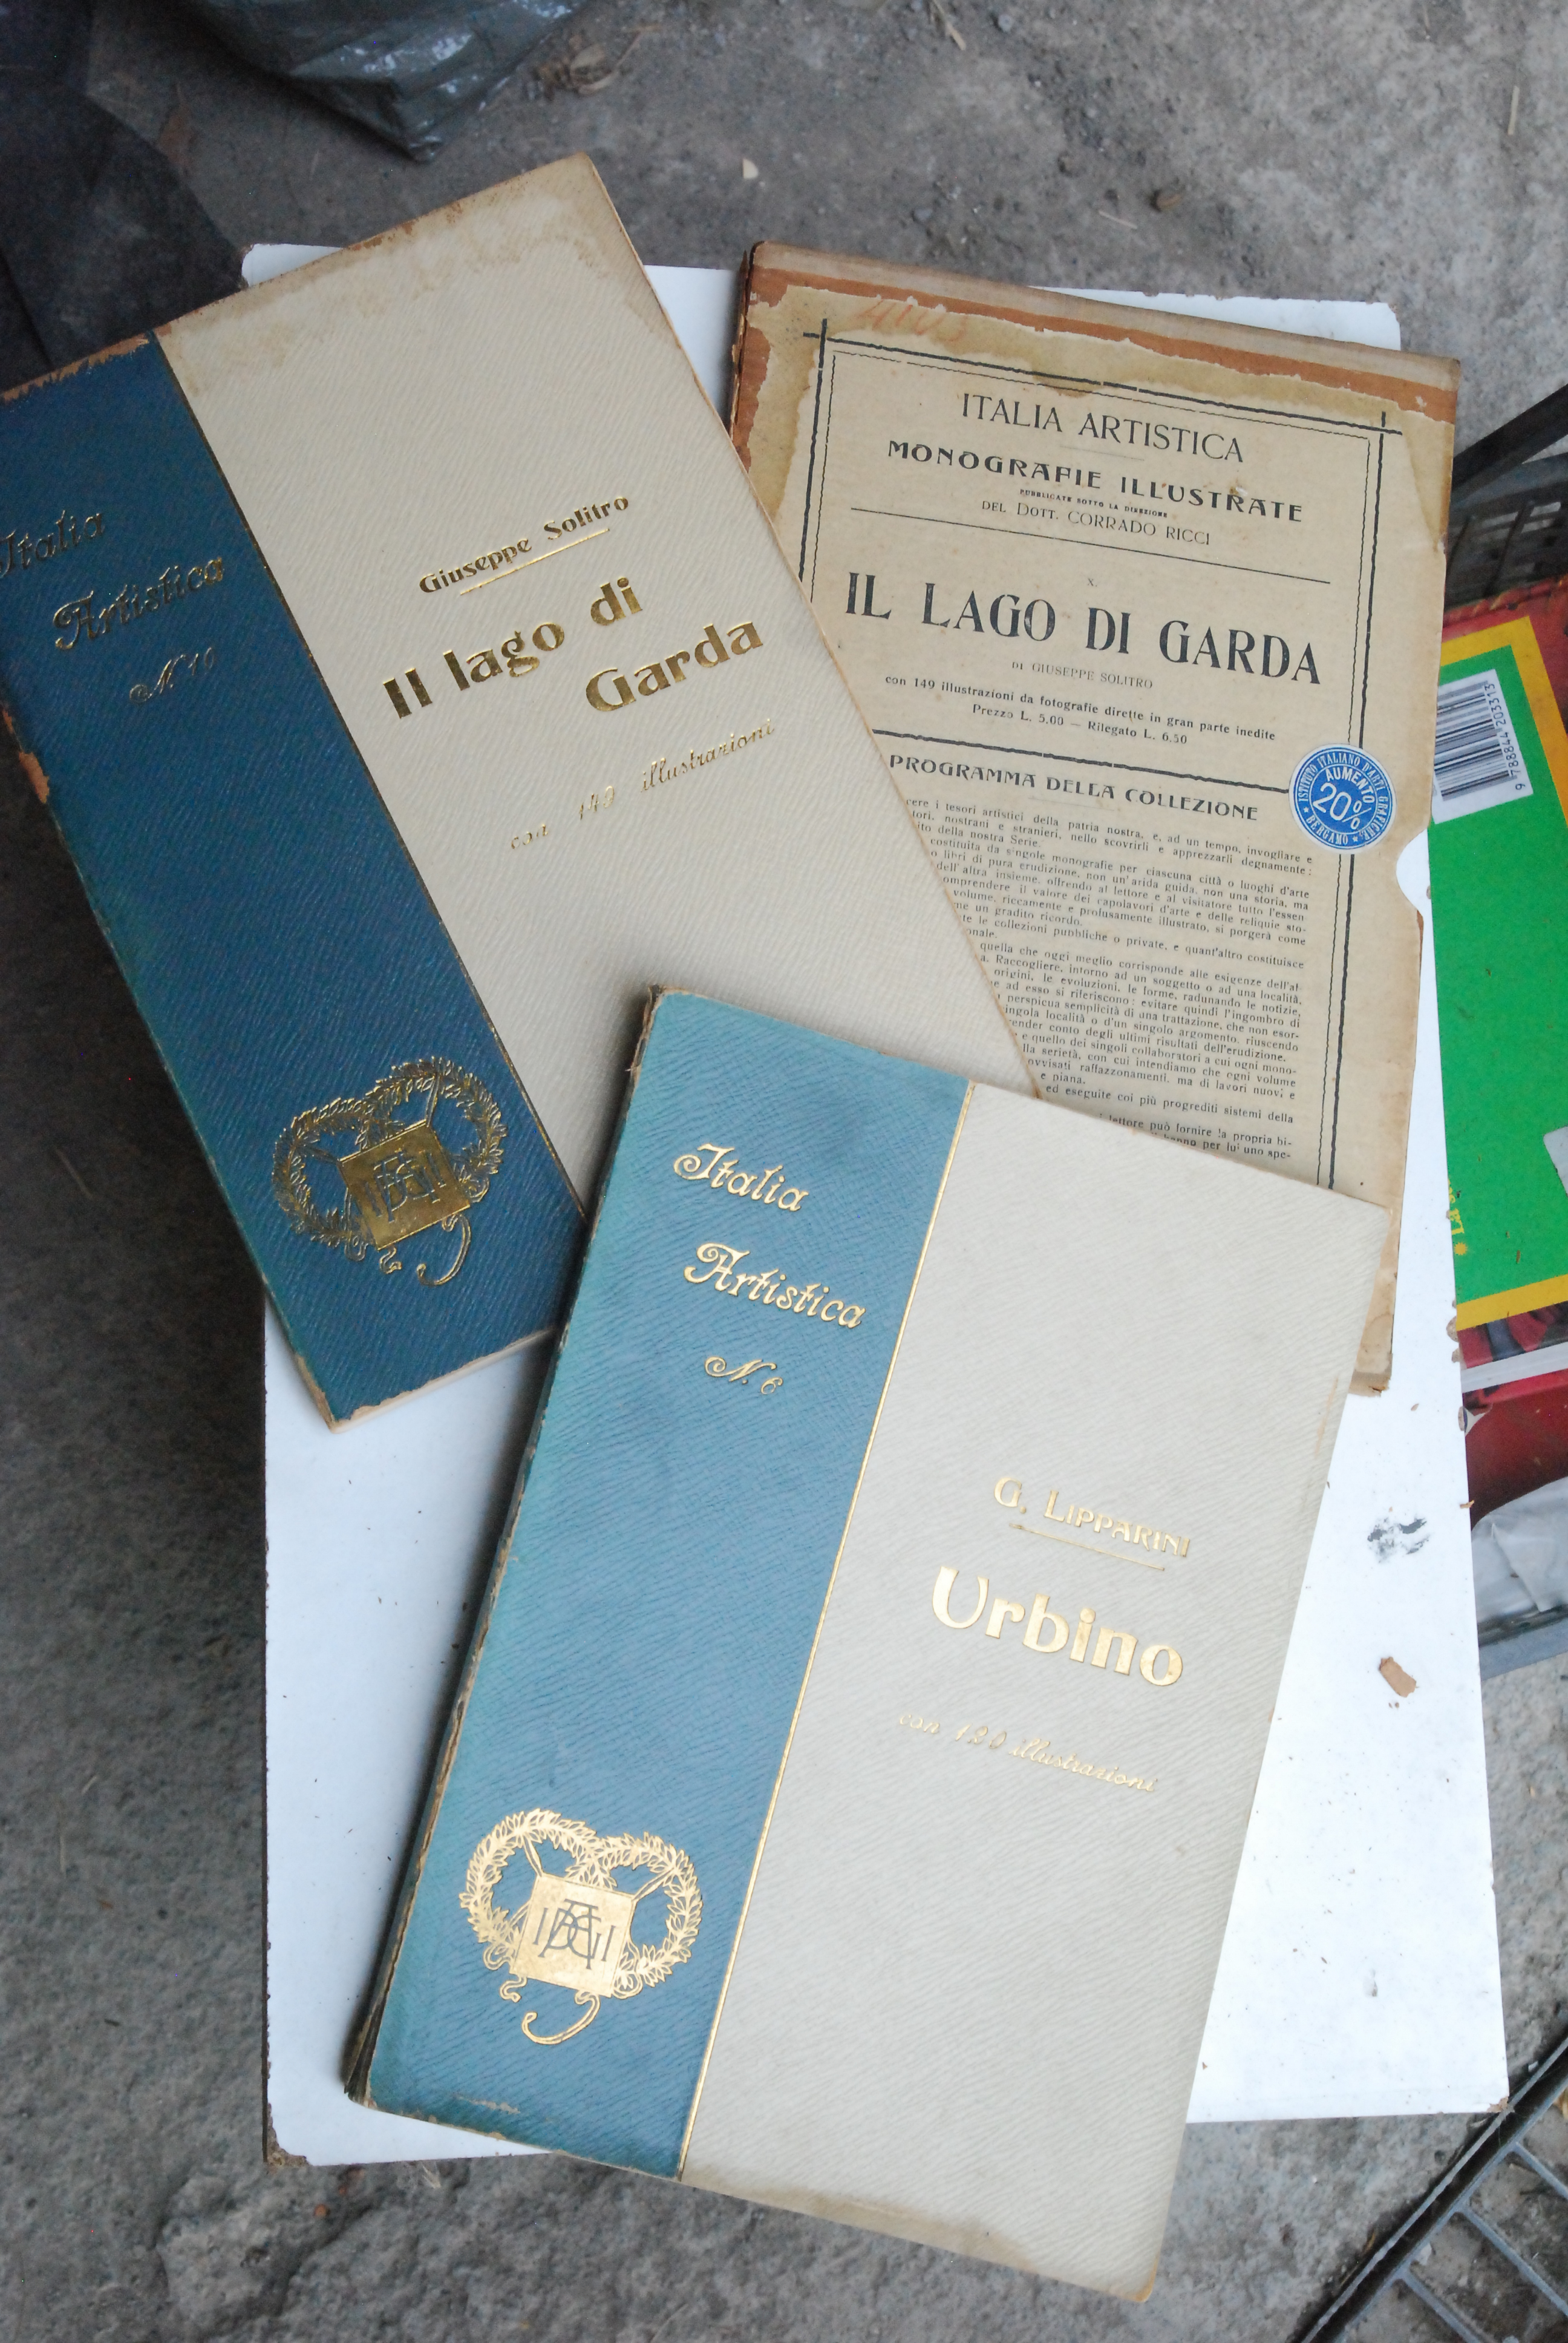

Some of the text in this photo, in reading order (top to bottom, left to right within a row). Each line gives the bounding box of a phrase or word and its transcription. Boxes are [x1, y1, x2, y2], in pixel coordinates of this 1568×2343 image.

[962, 392, 1244, 464] ITALIA ARTISTICA
[887, 439, 1302, 523] MONOGRAFIE ILLUSTRATE
[1076, 497, 1105, 508] SOTTO
[1108, 502, 1119, 511] LA
[418, 495, 629, 594] Giuseppe Solitro
[981, 500, 1007, 513] DEL
[1067, 510, 1157, 537] CORRADO
[1166, 525, 1210, 546] RICCI
[53, 556, 225, 650] Artistica
[844, 571, 1321, 686] IL LAGO DI GARDA
[382, 577, 643, 719] Il lago di
[585, 620, 763, 712] Garda
[1011, 661, 1154, 689] DI GIUSEPPE SOLITRO
[884, 676, 1276, 741] con 149 illustrazioni da fotografie dirette in gran parte inedite
[972, 703, 1014, 719] Prezzo
[1038, 713, 1064, 726] 5.00
[1087, 720, 1137, 738] Rilegato
[1161, 732, 1187, 745] 6.50
[1484, 683, 1506, 727] 203313
[1298, 763, 1318, 802] ISTITUTO
[1317, 750, 1361, 768] ITALIANO
[1500, 732, 1521, 777] 788844
[511, 822, 549, 850] con
[641, 718, 776, 792] illustrazioni
[889, 754, 1258, 822] PROGRAMMA DELLA COLLEZIONE
[1325, 765, 1376, 804] AUMENTO
[935, 799, 939, 810] i
[945, 802, 976, 815] tesori
[982, 808, 1024, 822] artistici
[1033, 814, 1059, 827] della
[1068, 821, 1099, 833] patria
[1167, 834, 1181, 844] ad
[1186, 838, 1200, 847] un
[1247, 845, 1301, 863] invogliare
[1305, 813, 1349, 845] BERGAMO
[930, 838, 981, 851] costituita
[987, 844, 1000, 854] da
[1051, 854, 1114, 871] monografie
[1119, 864, 1138, 874] per
[1146, 866, 1192, 882] ciascuna
[1198, 876, 1222, 886] città
[1240, 879, 1275, 894] luoghi
[979, 915, 988, 925] le
[994, 919, 1047, 934] collezioni
[1053, 928, 1108, 942] pubbliche
[1247, 954, 1304, 969] costituisce
[1002, 894, 1062, 911] riccamente
[1079, 907, 1152, 924] profusamente
[1215, 926, 1224, 934] si
[1229, 928, 1272, 942] porgerà
[1278, 936, 1306, 946] come
[979, 942, 1262, 987] quella che oggi meglio corrisponde alle esigenze
[1007, 995, 1060, 1009] perspicua
[1064, 1001, 1120, 1016] semplicità
[1123, 1007, 1134, 1018] di
[1138, 1011, 1158, 1021] una
[1226, 1021, 1245, 1033] che
[1248, 1026, 1269, 1036] non
[1043, 972, 1053, 983] le
[1128, 983, 1137, 995] le
[1183, 992, 1241, 1008] radunando
[1247, 999, 1256, 1011] le
[1087, 1054, 1107, 1063] con
[1113, 1057, 1130, 1066] cui
[1135, 1059, 1197, 1075] intendiamo
[1202, 1066, 1221, 1078] che
[1226, 1071, 1250, 1082] ogni
[1256, 1074, 1296, 1088] volume
[1045, 1084, 1293, 1124] ed eseguite coi più progrediti sistemi della
[1202, 1140, 1221, 1151] per
[1243, 1146, 1264, 1156] uno
[673, 1142, 809, 1212] Italia
[684, 1241, 866, 1329] Artistica
[760, 1376, 784, 1395] 6
[994, 1476, 1027, 1515] G.
[932, 1565, 1184, 1687] Urbino
[899, 1712, 1160, 1793] con 120 illustrazioni
